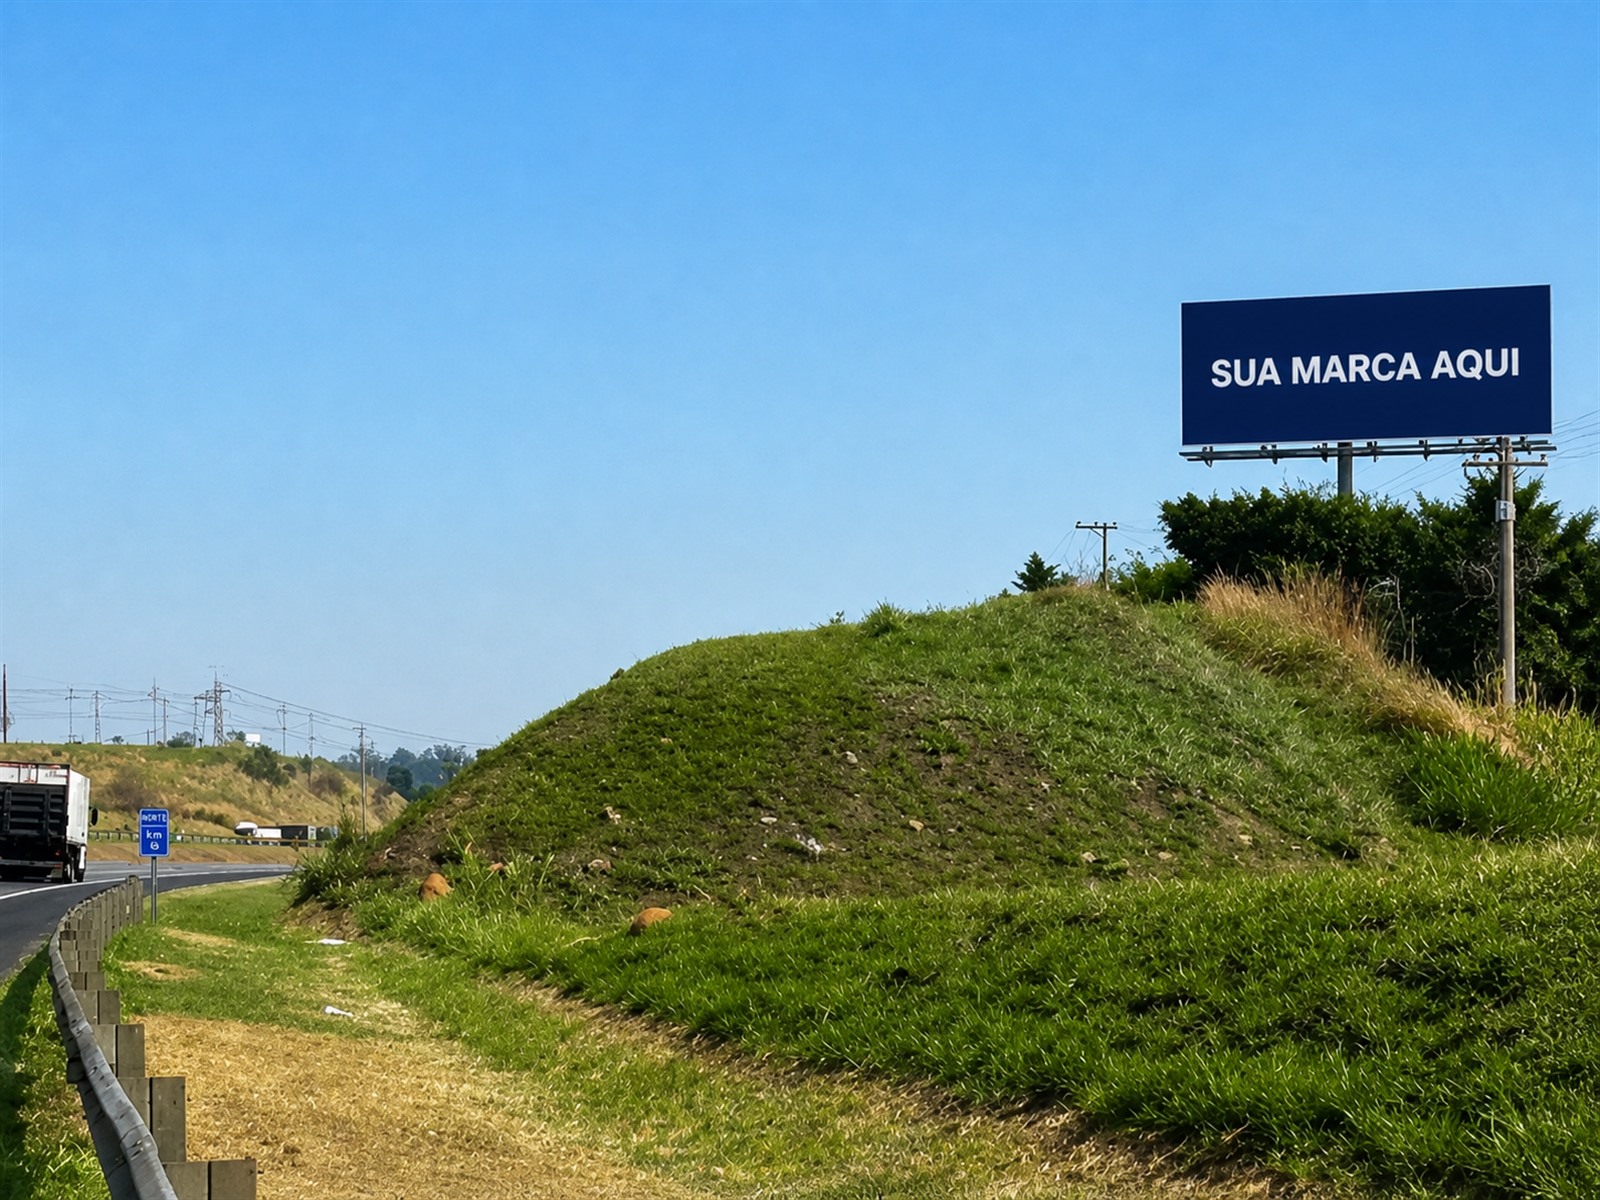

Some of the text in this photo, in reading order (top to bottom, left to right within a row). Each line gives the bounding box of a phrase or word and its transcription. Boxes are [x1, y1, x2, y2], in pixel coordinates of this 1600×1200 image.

[1210, 348, 1519, 388] SUA MARCA AQUI
[146, 830, 162, 839] km
